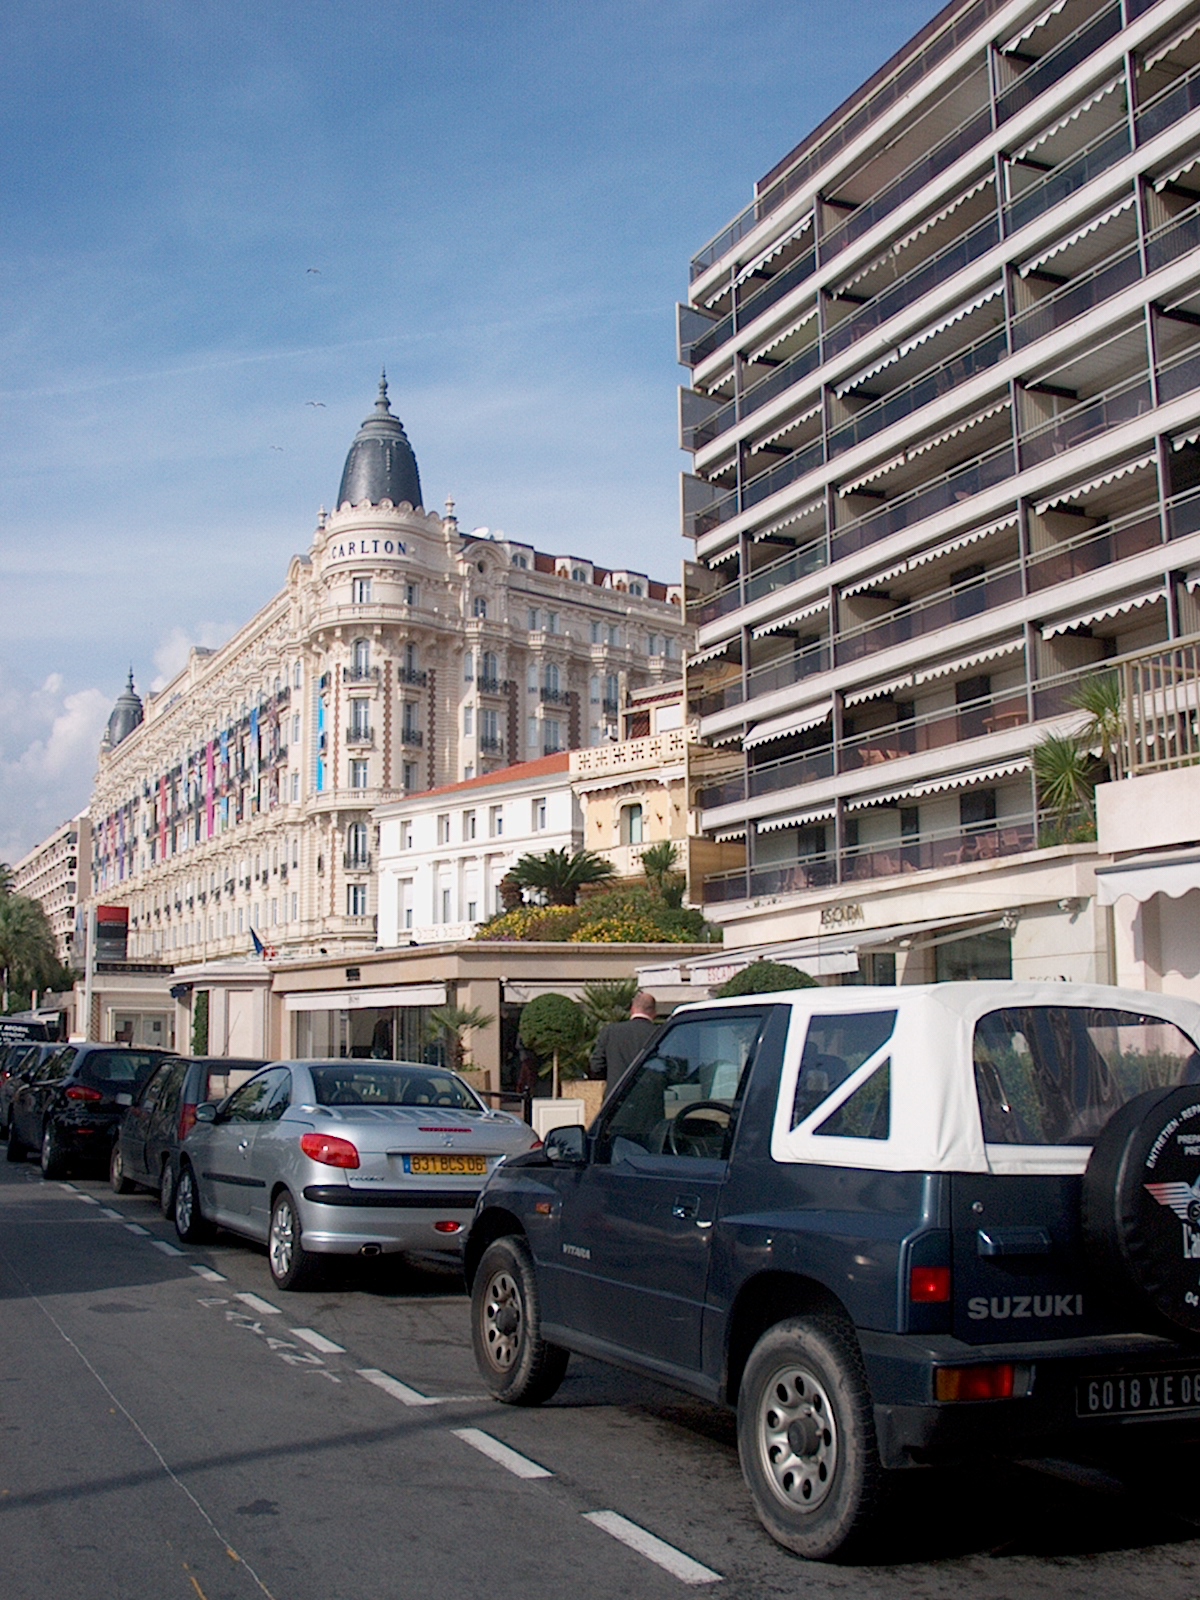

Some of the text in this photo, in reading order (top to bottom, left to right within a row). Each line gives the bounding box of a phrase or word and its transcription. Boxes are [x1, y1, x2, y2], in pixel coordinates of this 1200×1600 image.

[331, 540, 407, 559] CARLTON
[1146, 1118, 1180, 1169] ENTRETIEN
[468, 1156, 484, 1171] 06
[967, 1294, 1083, 1320] SUZUKI
[196, 1298, 342, 1383] PAYANT
[1088, 1379, 1141, 1411] 6018
[1149, 1376, 1174, 1406] XE
